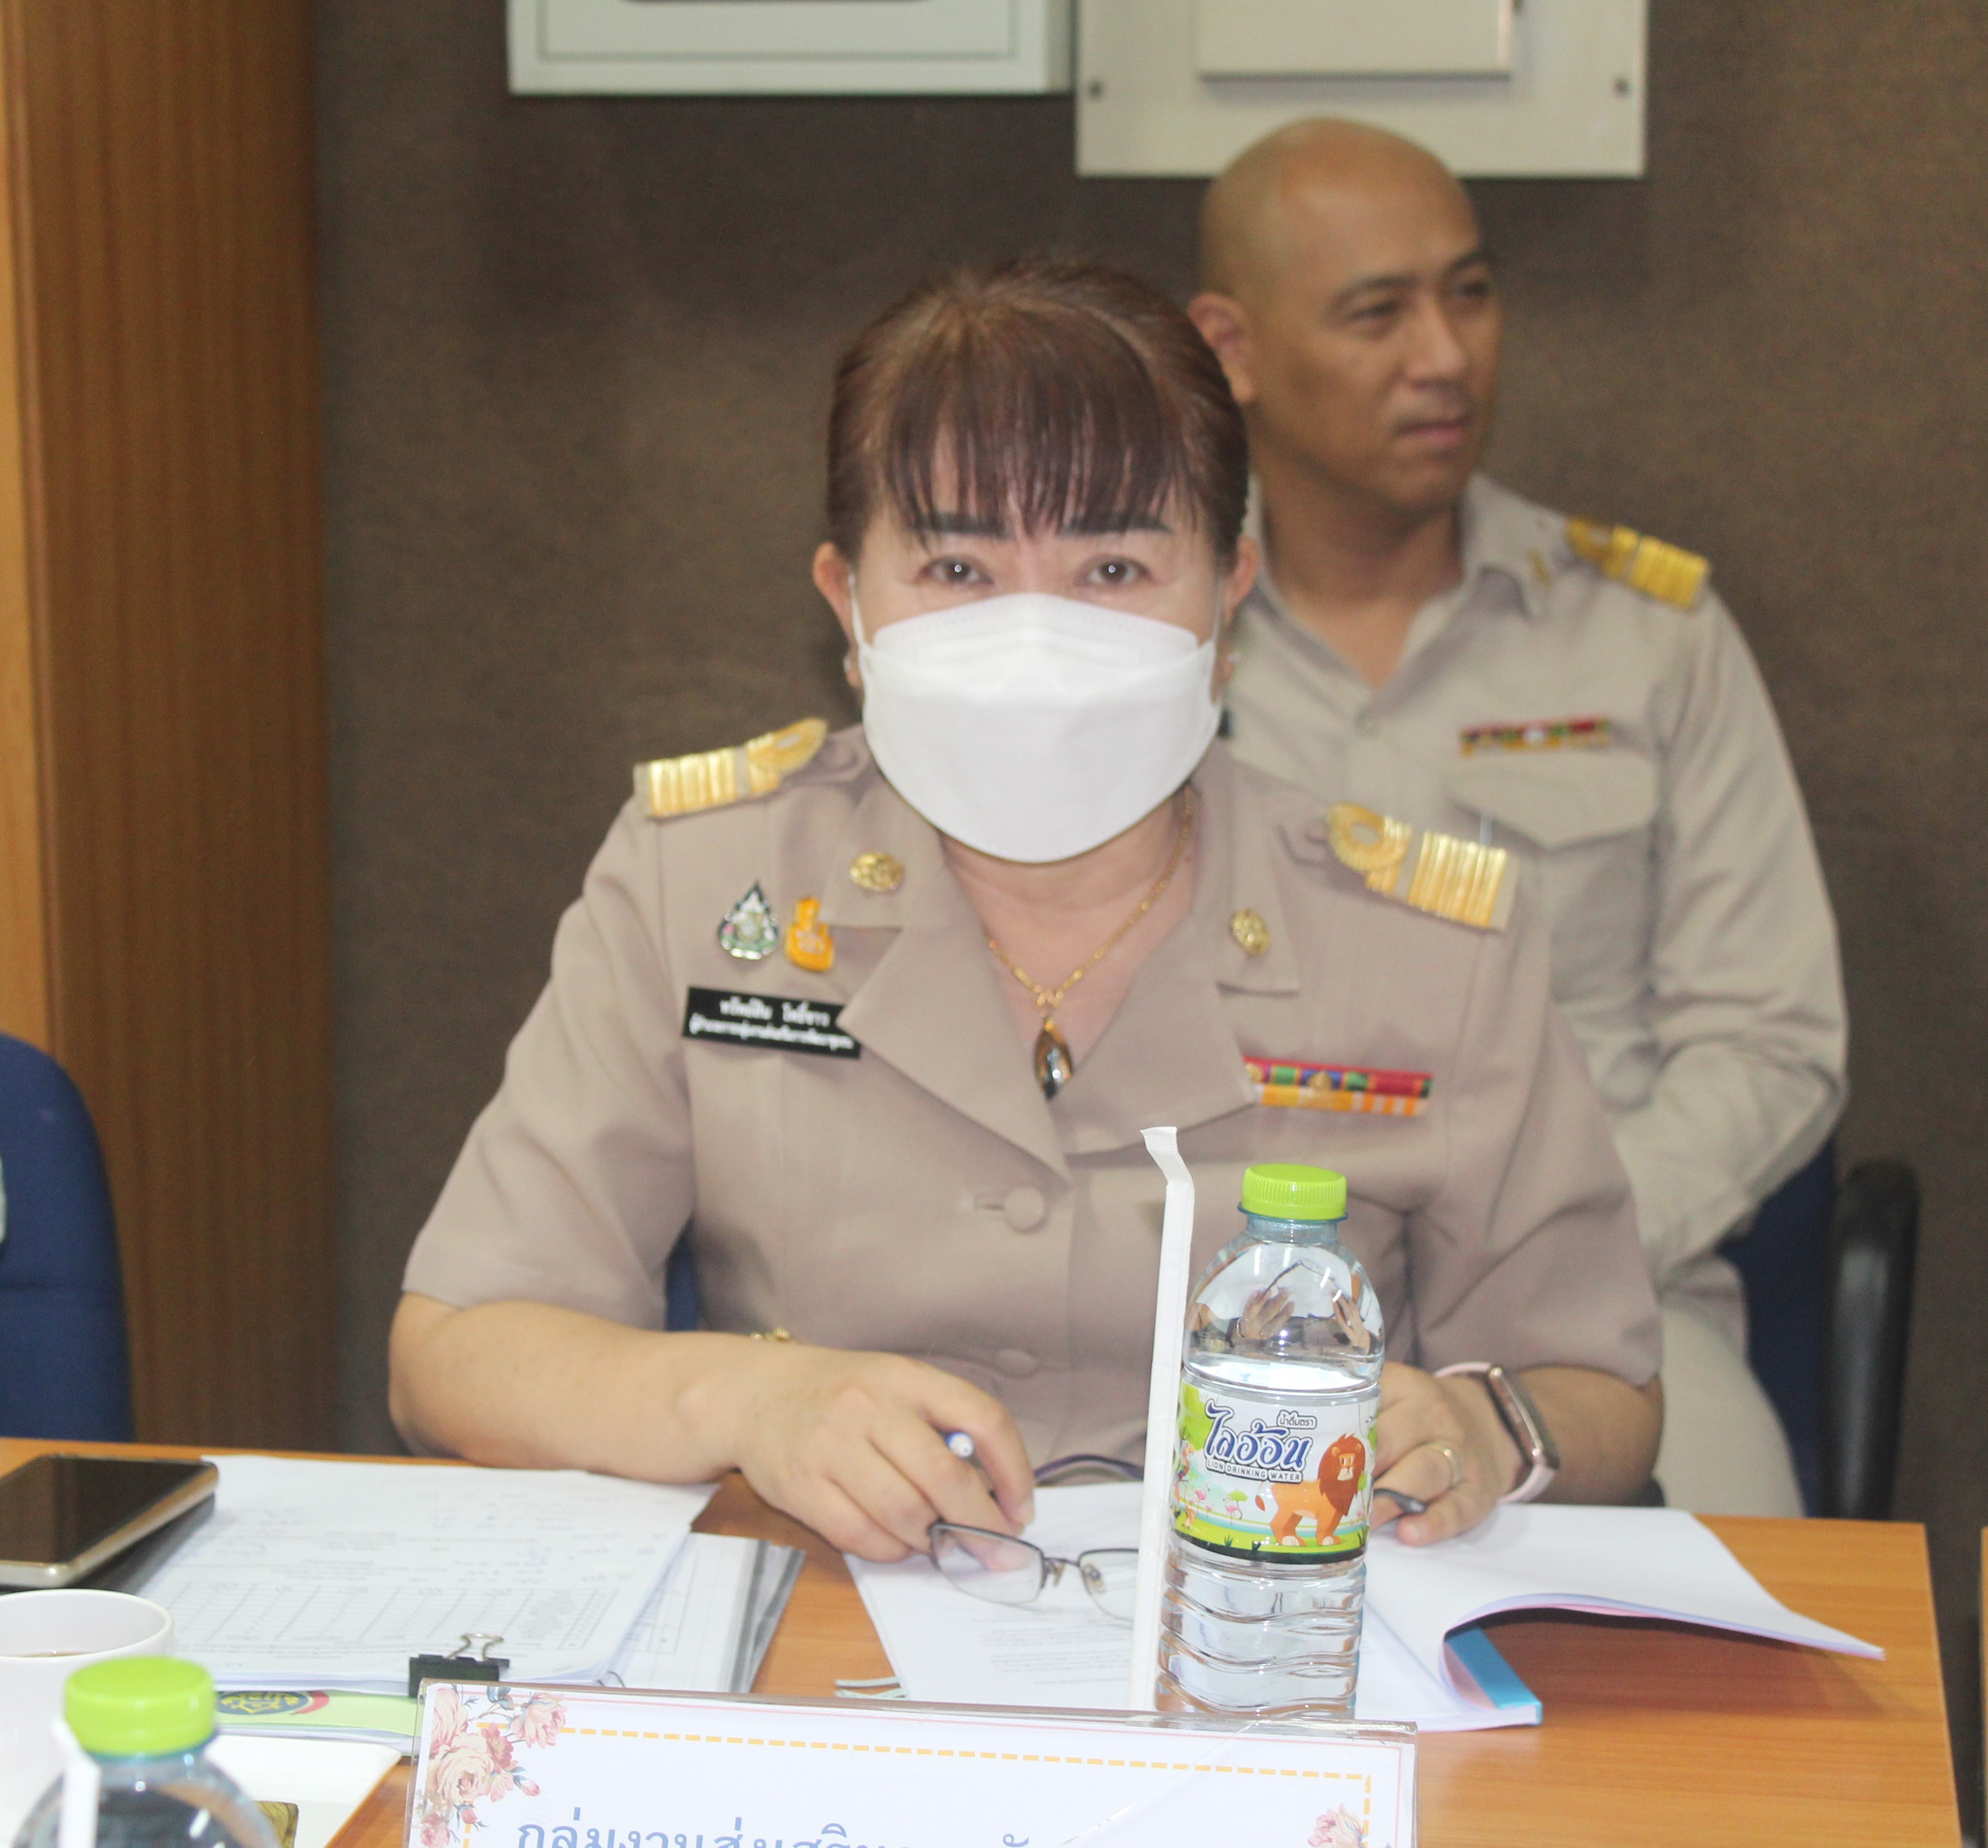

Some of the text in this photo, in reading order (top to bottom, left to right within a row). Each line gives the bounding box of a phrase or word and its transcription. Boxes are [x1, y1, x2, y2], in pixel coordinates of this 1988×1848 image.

[1206, 1401, 1311, 1468] ไลอ้อน
[1207, 1459, 1300, 1481] LION DRINKING WATER
